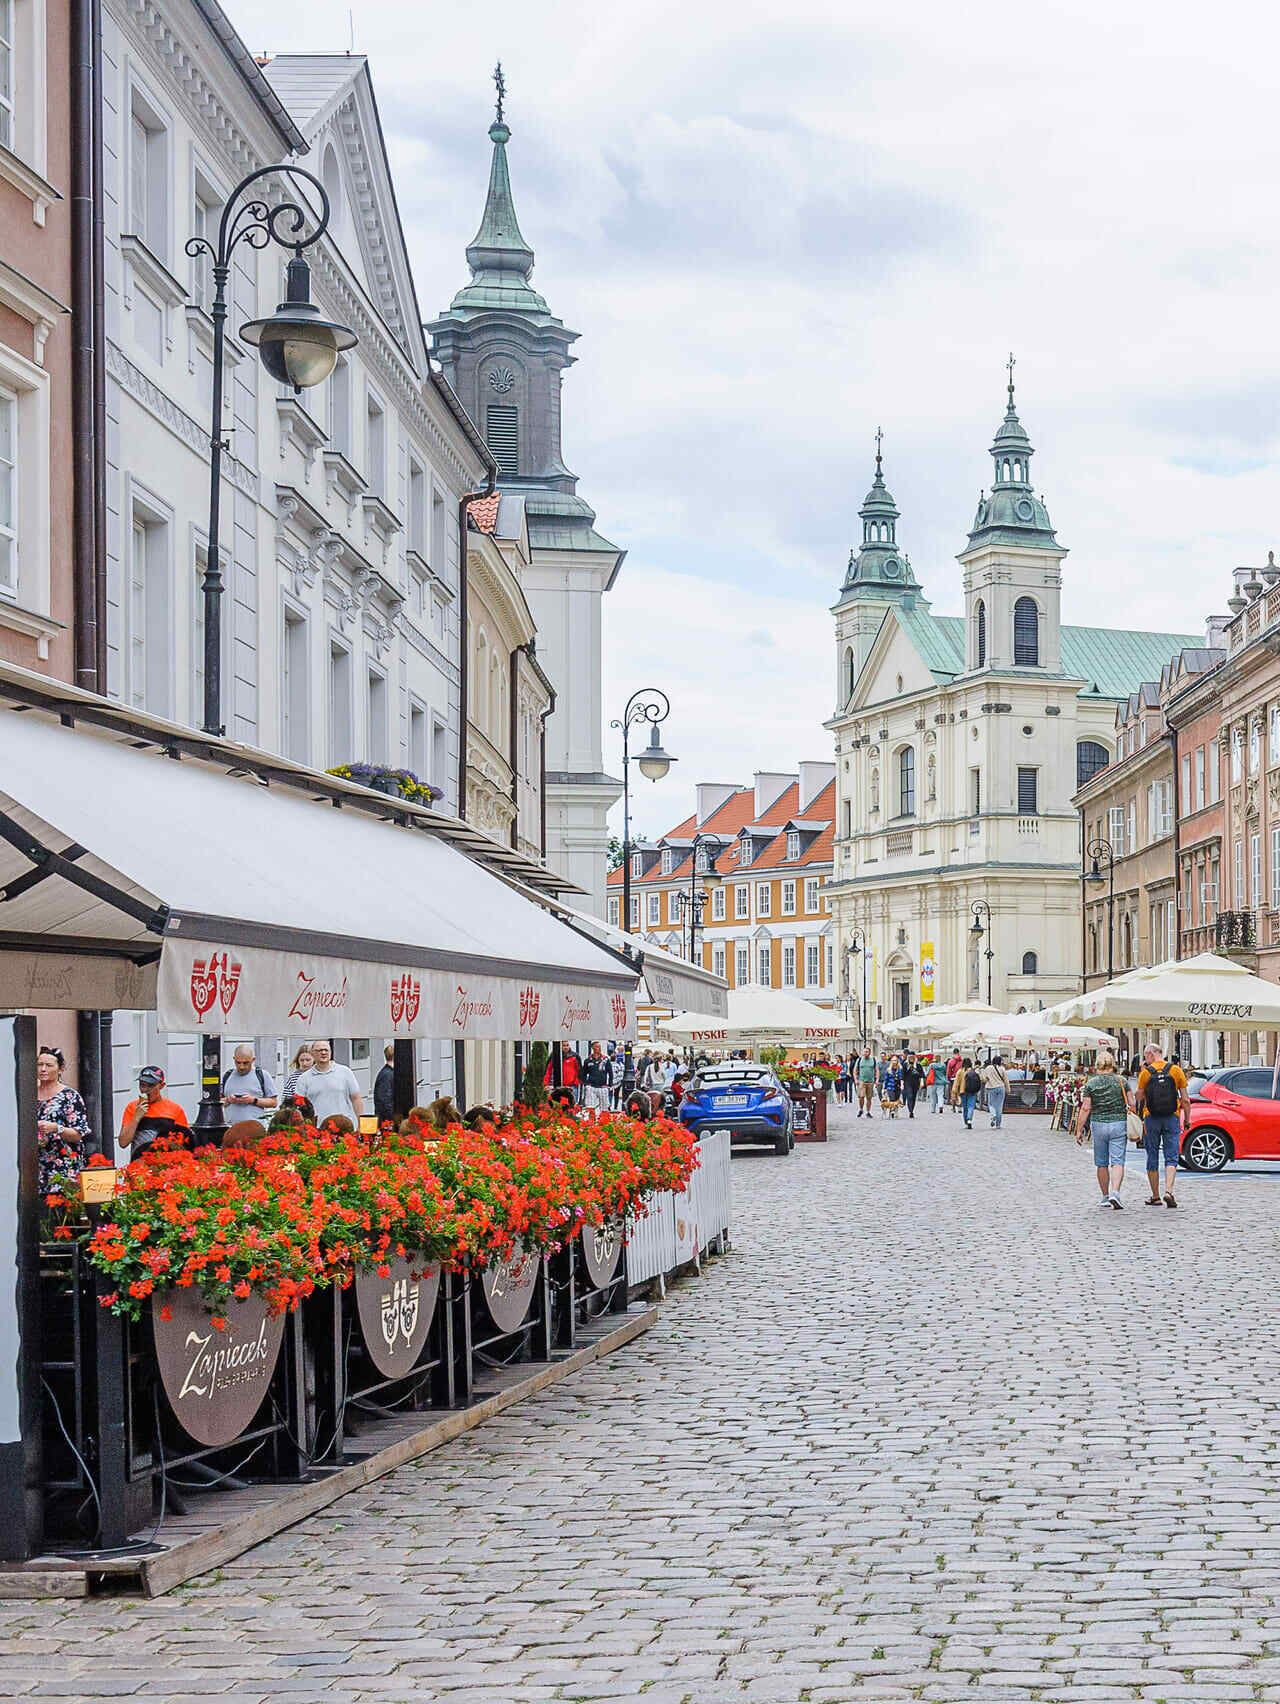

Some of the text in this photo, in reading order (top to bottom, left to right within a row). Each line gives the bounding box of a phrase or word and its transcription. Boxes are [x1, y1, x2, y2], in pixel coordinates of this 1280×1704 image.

[1188, 1002, 1253, 1018] PASIEKA
[691, 1029, 728, 1041] TYSKIE
[804, 1027, 841, 1038] TYSKIE
[178, 1318, 268, 1400] Zapiecek
